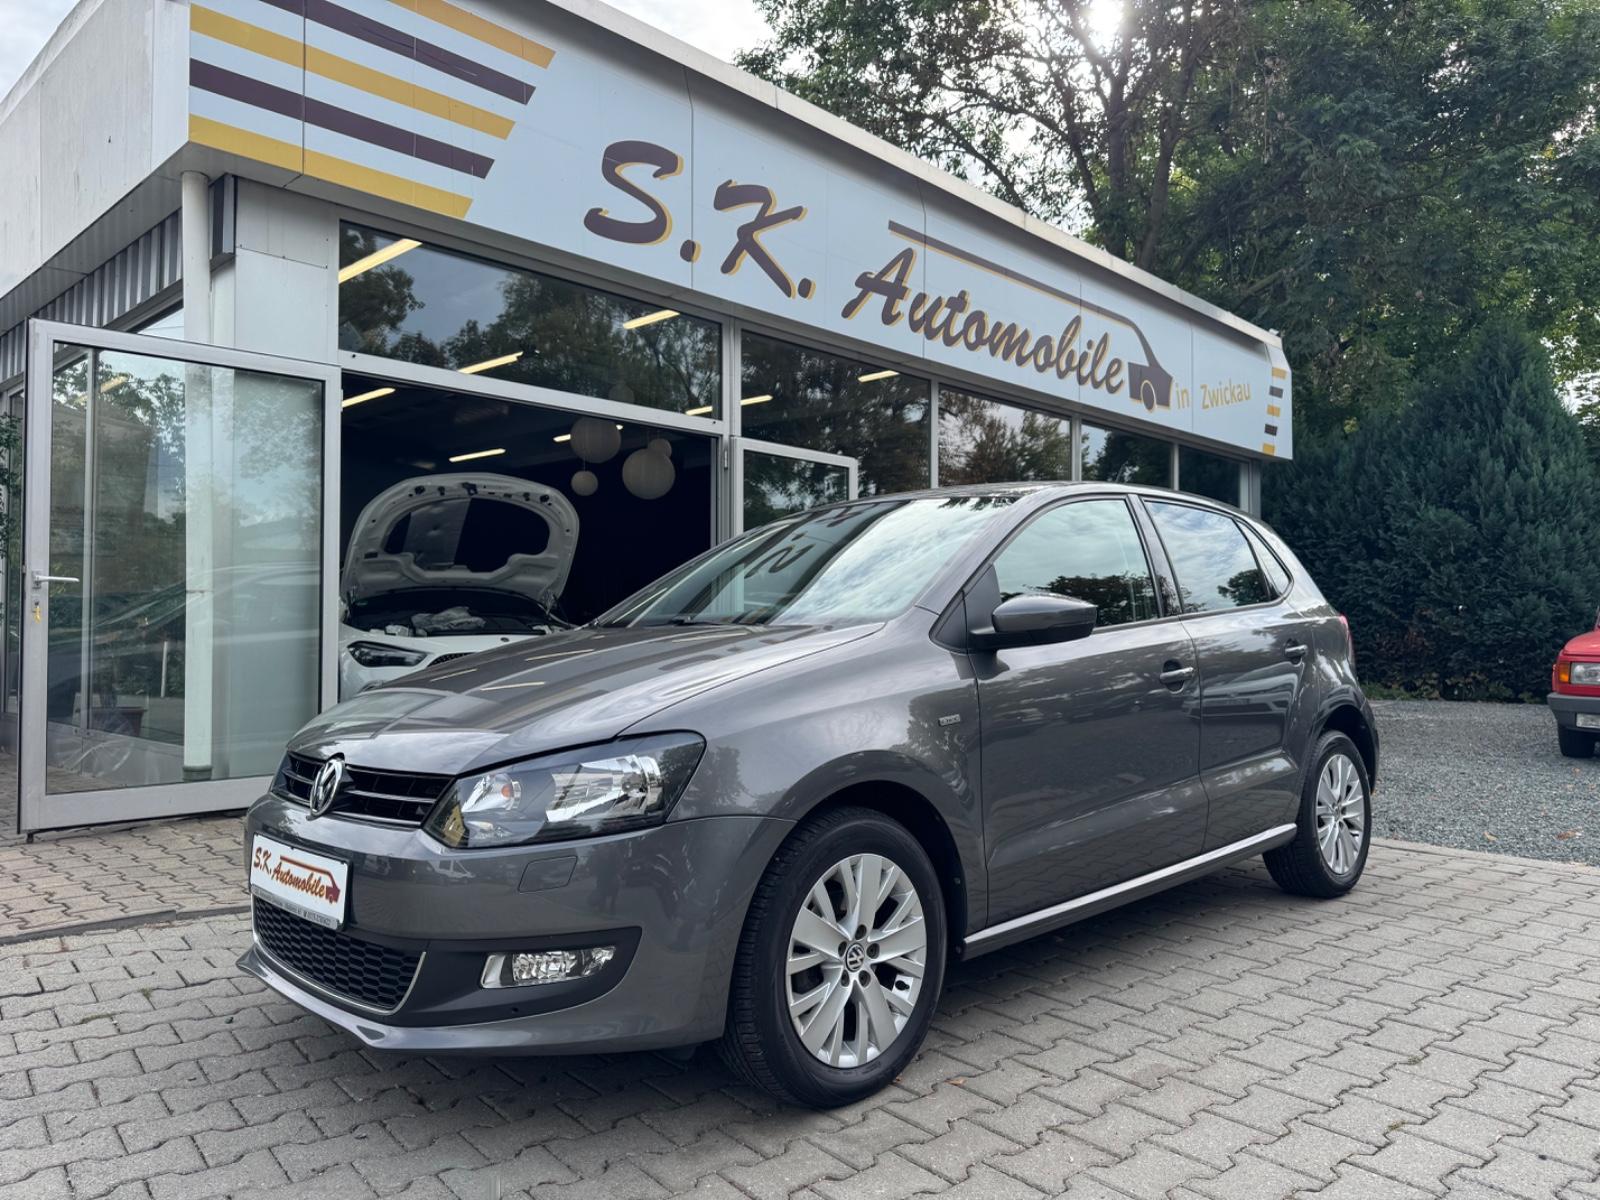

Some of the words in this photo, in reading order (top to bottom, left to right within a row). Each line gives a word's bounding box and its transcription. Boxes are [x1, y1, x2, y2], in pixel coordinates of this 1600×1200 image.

[841, 247, 1124, 395] Automobile
[1175, 382, 1190, 409] in
[1200, 377, 1251, 410] Zwickau
[271, 861, 325, 897] Automobile
